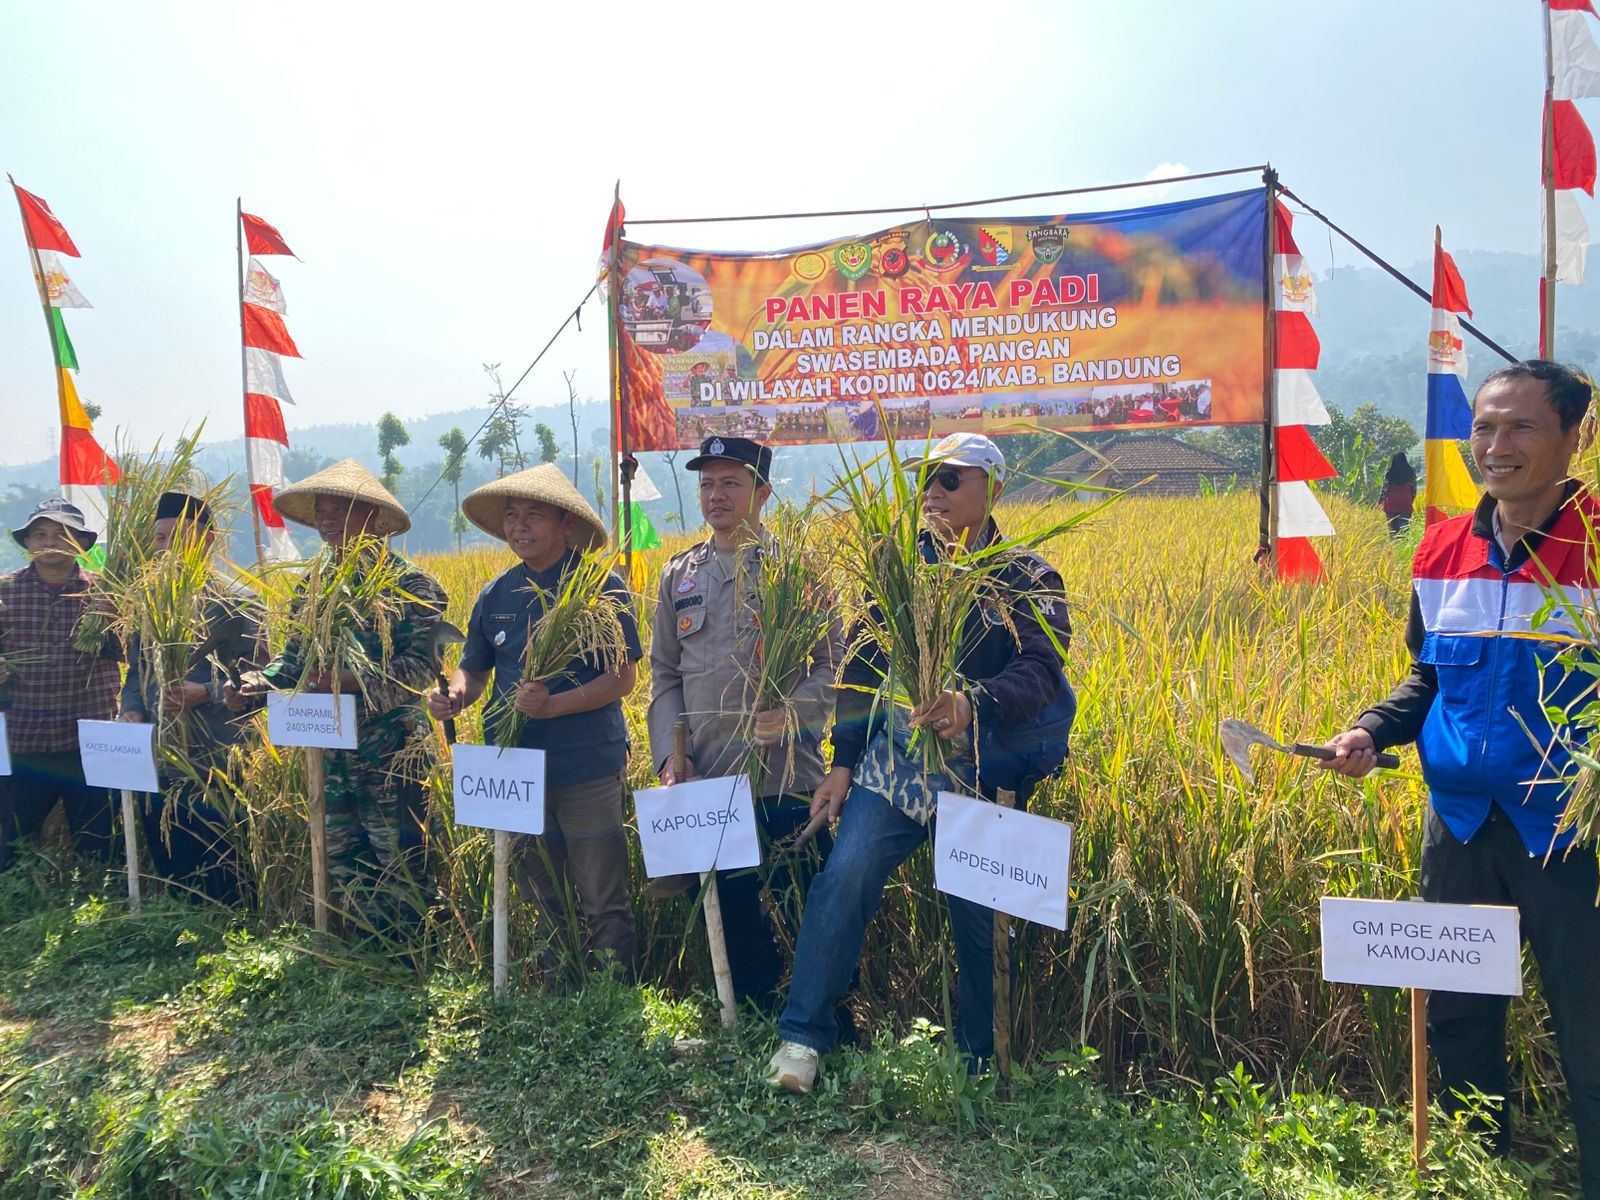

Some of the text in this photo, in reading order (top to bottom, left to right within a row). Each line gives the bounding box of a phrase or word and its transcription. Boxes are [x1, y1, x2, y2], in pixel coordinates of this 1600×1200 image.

[765, 273, 1098, 324] PANEN RAYA PADI
[753, 307, 1117, 350] DALAM RANGKA MENDUKUNG
[796, 337, 1070, 374] SWASEMBADA PANGAN
[699, 382, 721, 401] DI
[728, 377, 832, 401] WILAYAH
[840, 372, 915, 396] KODIM
[922, 364, 1045, 391] 0624/KAB.
[1052, 355, 1181, 383] BANDUNG
[288, 707, 336, 719] DANRAMIL
[86, 742, 143, 755] KADES LAKSANA
[460, 775, 535, 802] CAMAT
[652, 808, 740, 834] KAPOLSEK
[949, 848, 1048, 890] APDESI IBUN
[1352, 920, 1496, 943] GM PGE AREA
[1367, 943, 1481, 965] KAMOJANG
